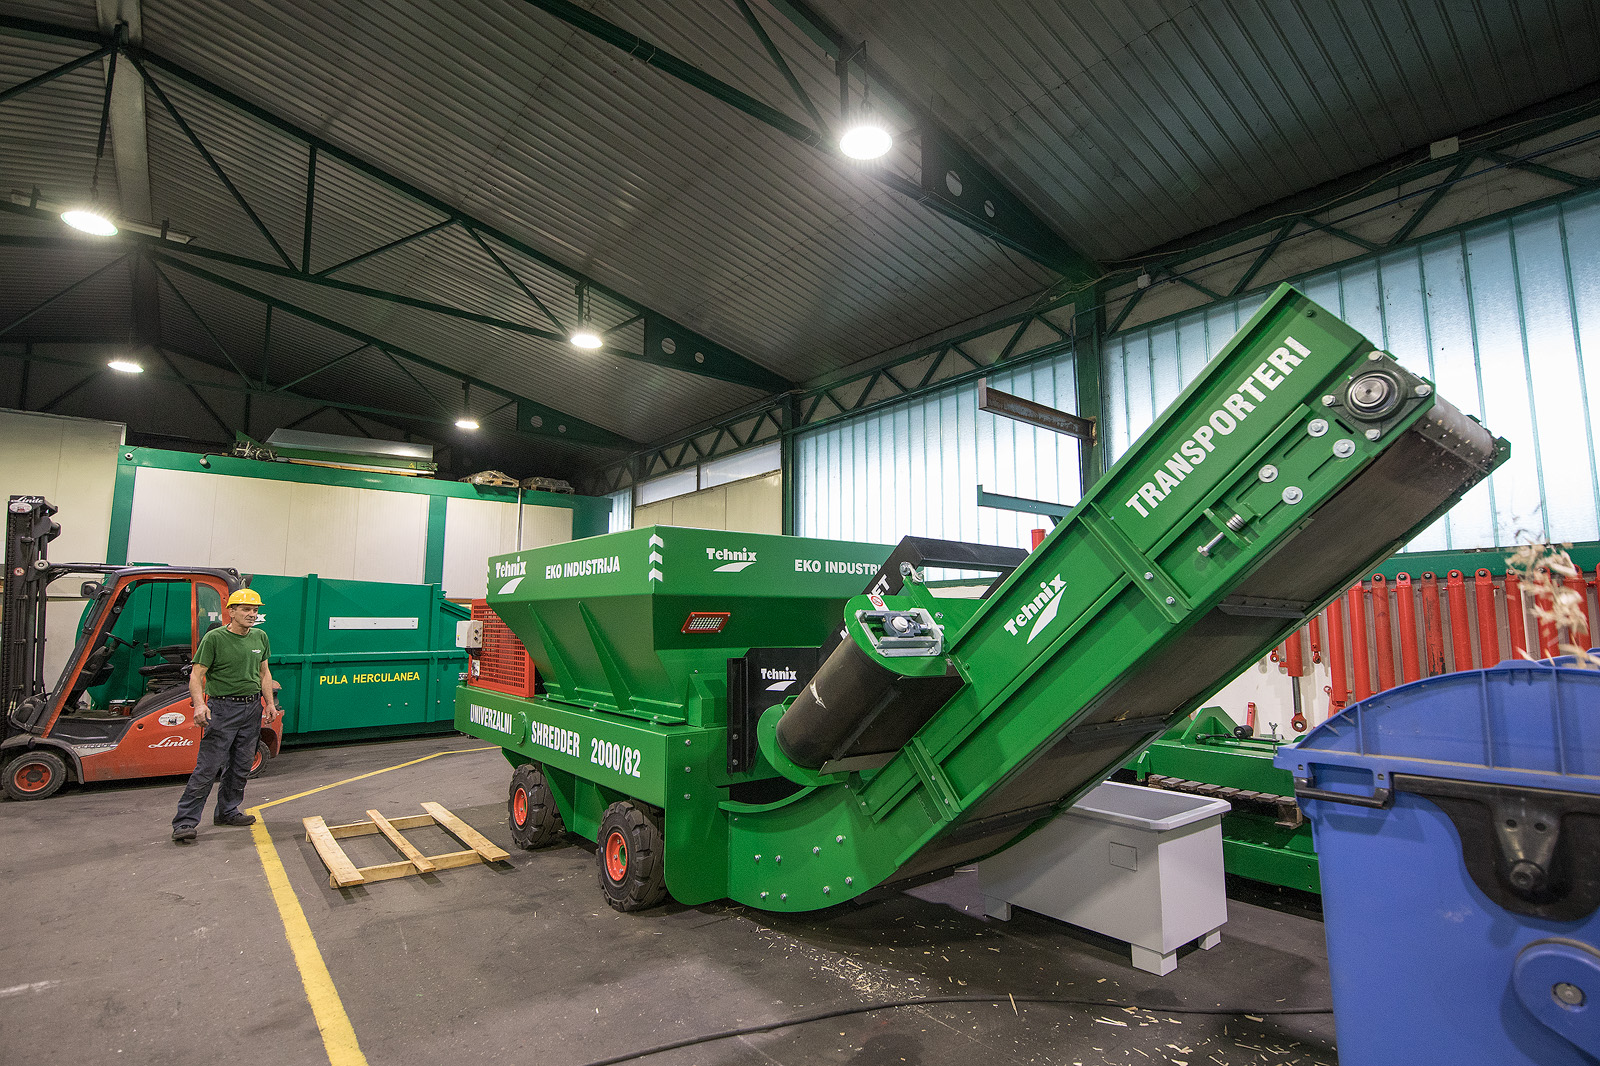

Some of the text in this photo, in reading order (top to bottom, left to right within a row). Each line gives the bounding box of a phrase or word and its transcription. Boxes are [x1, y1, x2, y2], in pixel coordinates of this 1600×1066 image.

[1125, 336, 1312, 518] TRANSPORTERI
[706, 547, 757, 562] Tehnix
[495, 555, 527, 579] Tehnix
[545, 556, 620, 580] EKO INDUSTRIJA
[794, 559, 882, 576] EKO INDUSTRI
[1003, 573, 1067, 636] Tehnix
[319, 671, 420, 685] PULA HERCULANEA
[760, 666, 797, 680] Tehnix
[148, 735, 194, 748] Linde
[470, 703, 641, 778] UNIVERZALNI SHREDDER 2000/82
